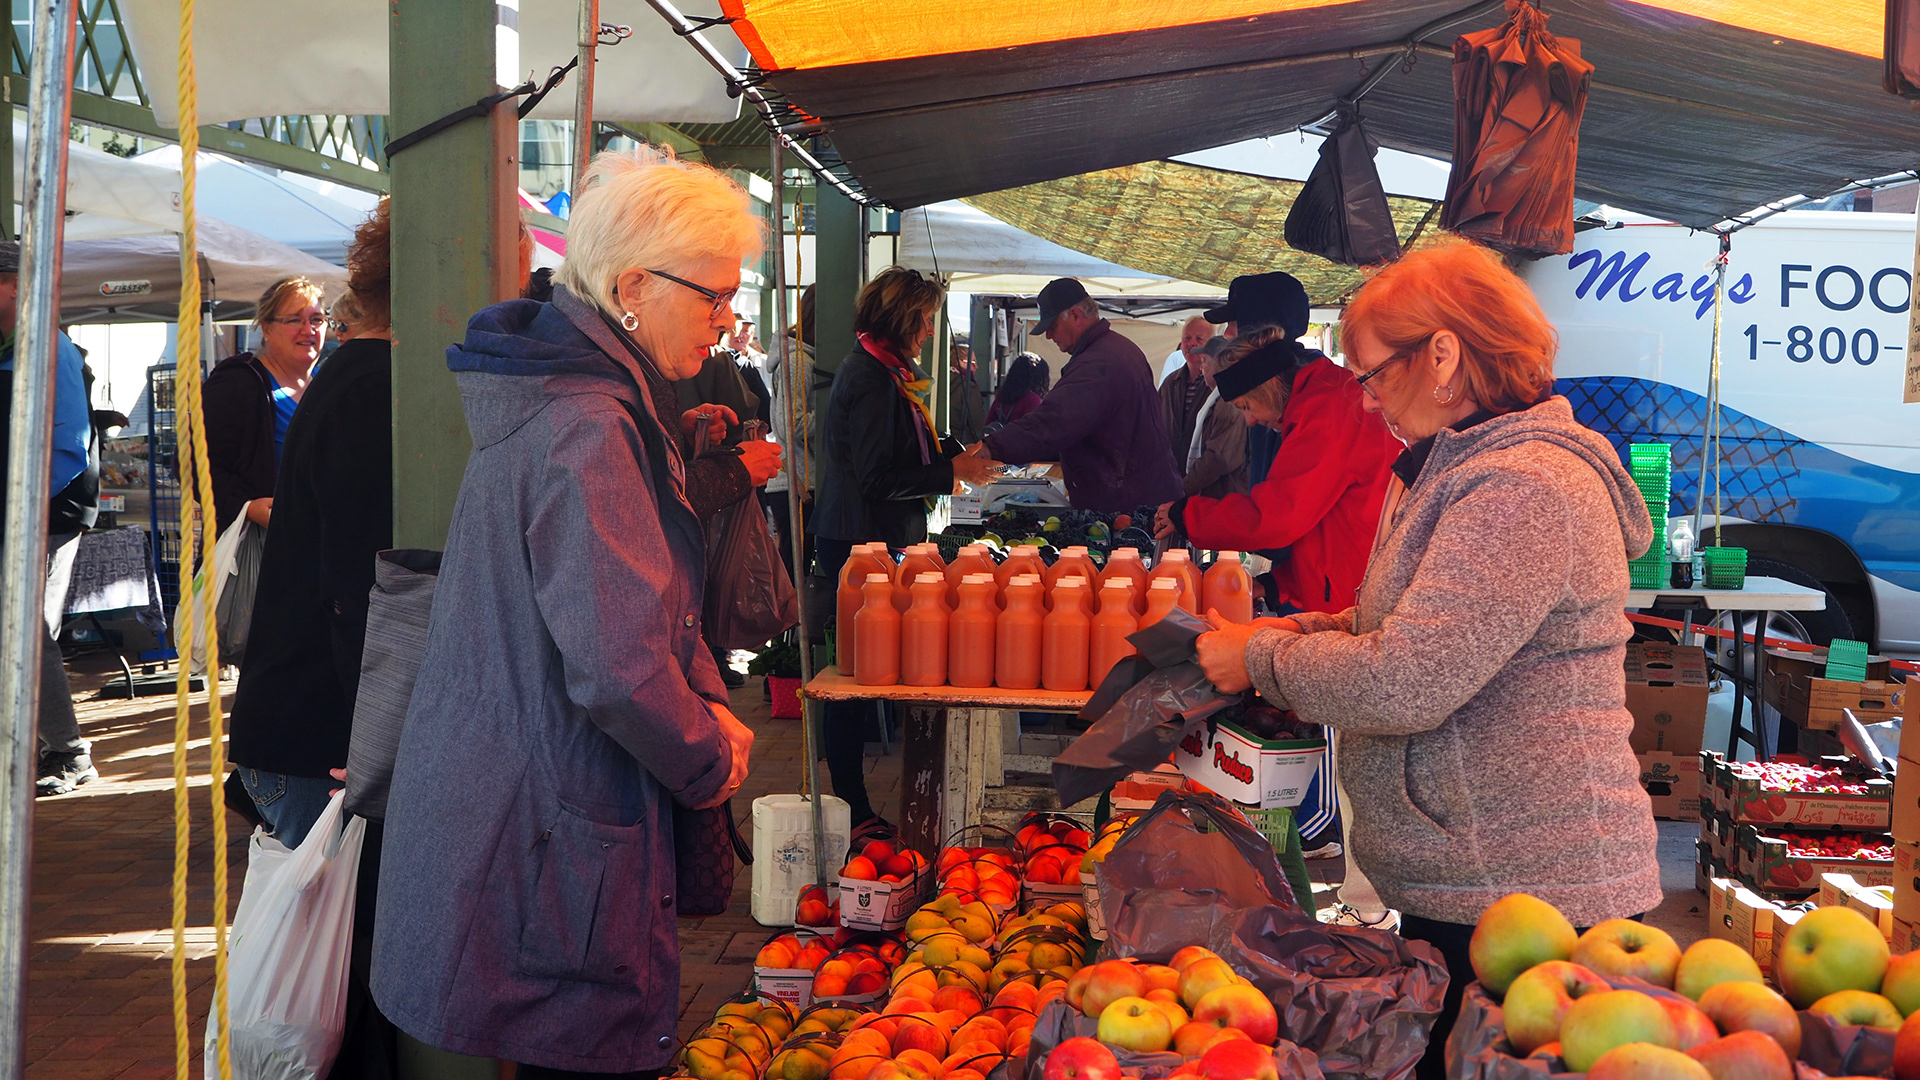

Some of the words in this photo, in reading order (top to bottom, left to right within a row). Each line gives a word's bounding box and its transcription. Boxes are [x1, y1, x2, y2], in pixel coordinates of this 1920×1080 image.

[1568, 248, 1756, 320] Mays
[1780, 263, 1912, 314] FOO
[1179, 730, 1203, 757] esh
[1214, 741, 1254, 785] Produce
[1277, 787, 1299, 797] LITRES
[1788, 800, 1823, 824] Les
[1834, 806, 1876, 825] fraises
[1866, 872, 1893, 887] frais
